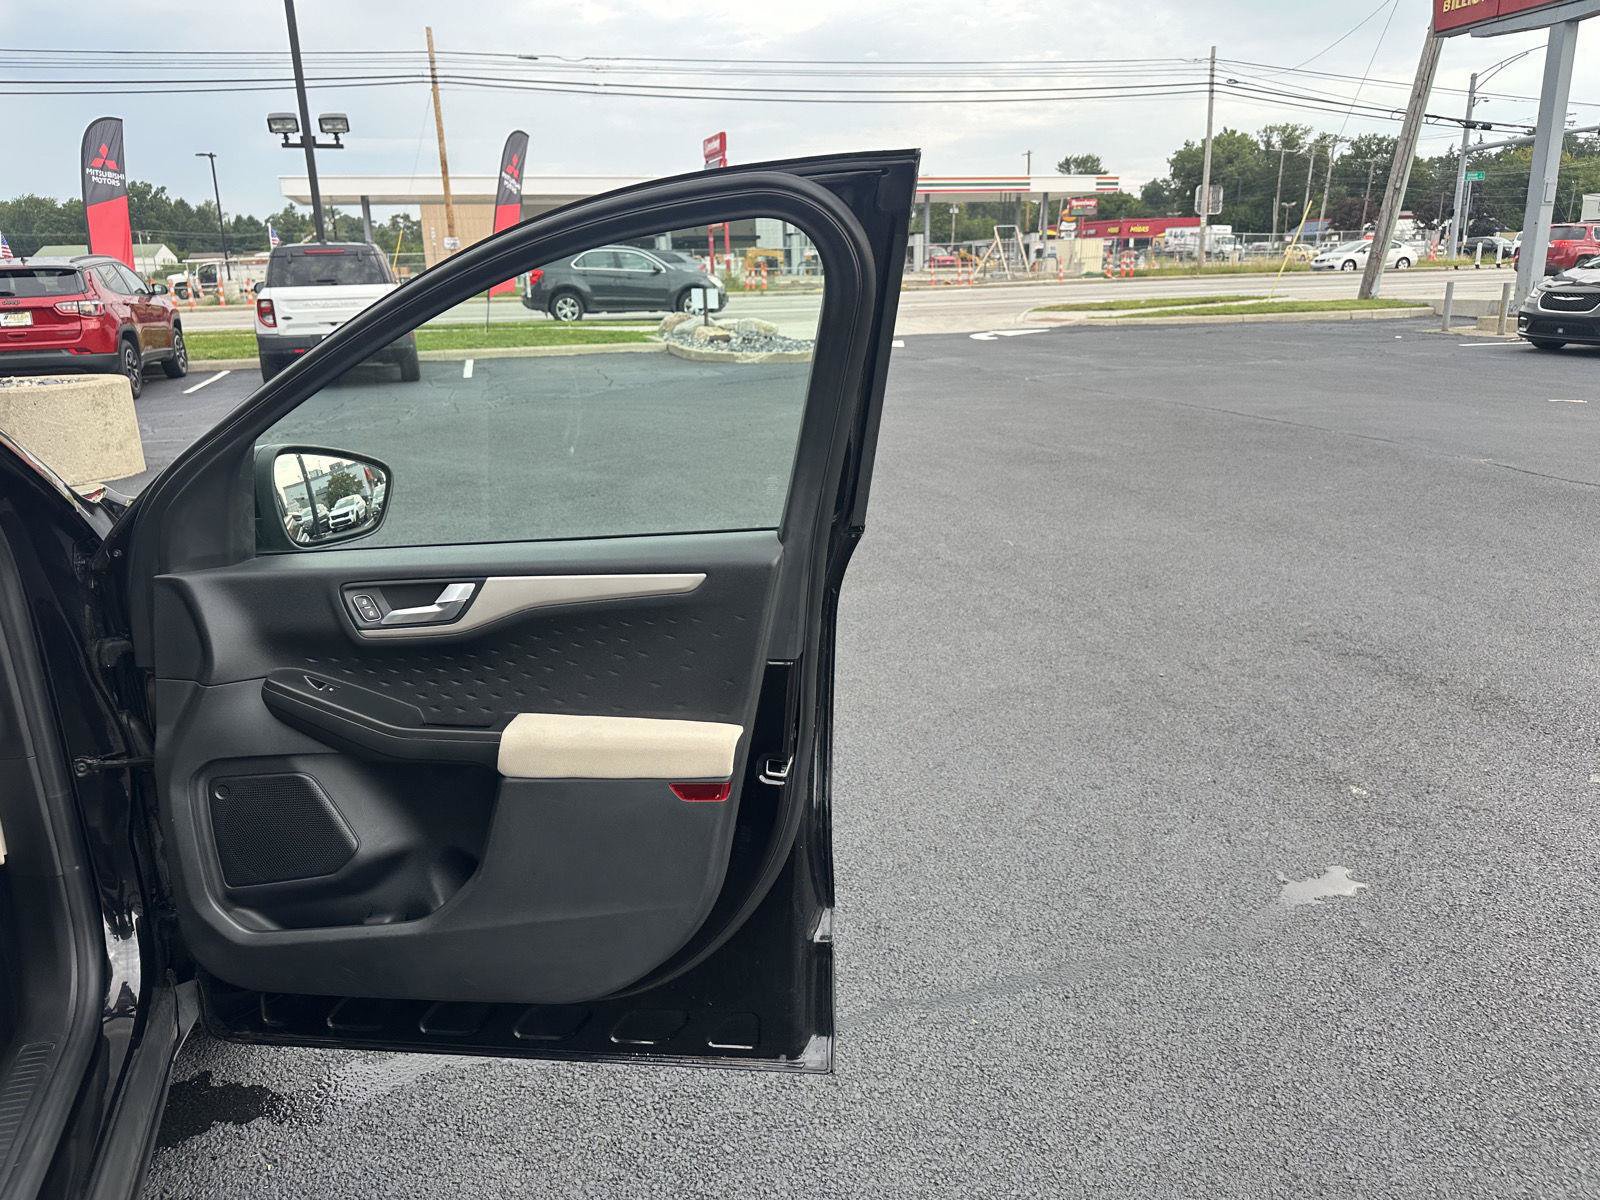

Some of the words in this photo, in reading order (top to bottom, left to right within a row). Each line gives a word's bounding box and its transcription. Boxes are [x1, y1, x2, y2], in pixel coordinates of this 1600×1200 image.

[1443, 0, 1485, 13] BILL
[86, 167, 125, 180] MITSUBISHI
[91, 176, 121, 187] MOTORS
